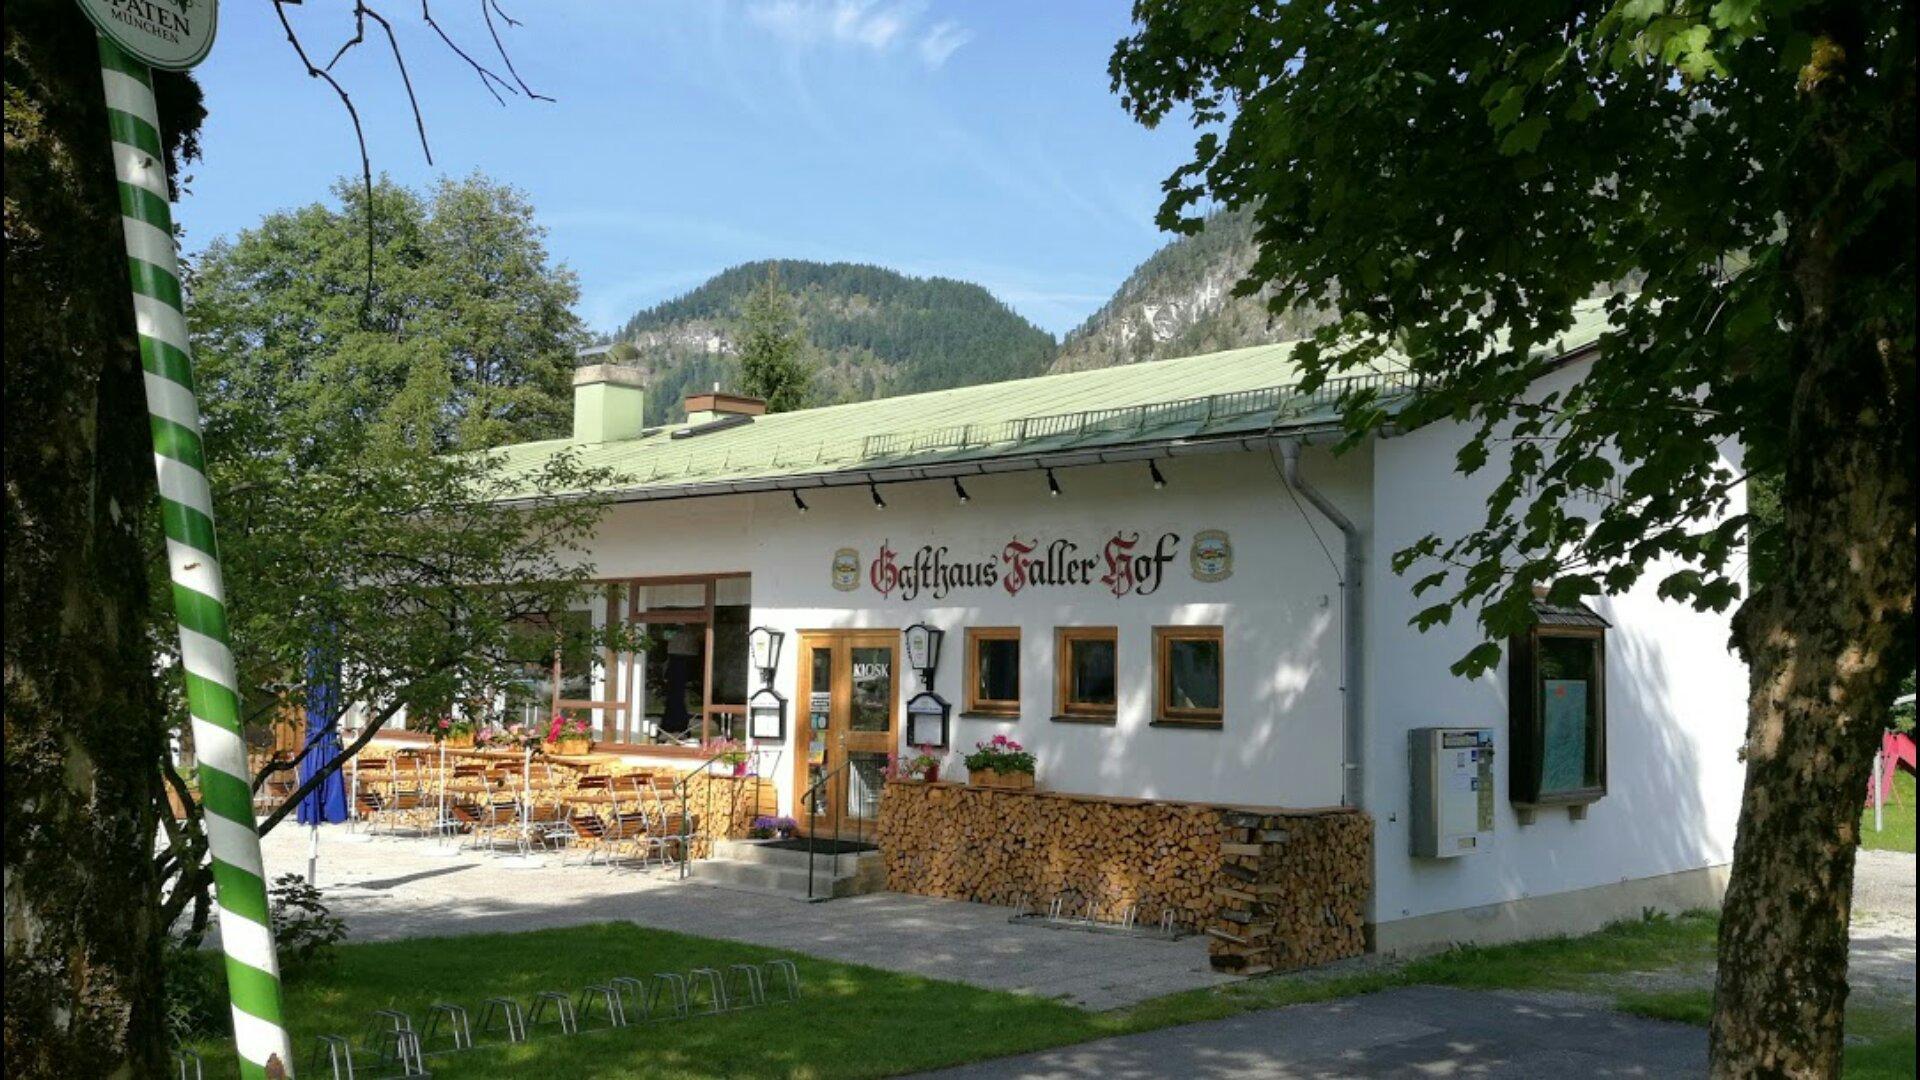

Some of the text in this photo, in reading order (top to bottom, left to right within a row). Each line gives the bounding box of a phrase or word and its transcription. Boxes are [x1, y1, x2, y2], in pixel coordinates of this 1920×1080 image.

[1002, 535, 1099, 597] Faller
[1101, 530, 1180, 599] Hof
[853, 663, 889, 678] KIOSK
